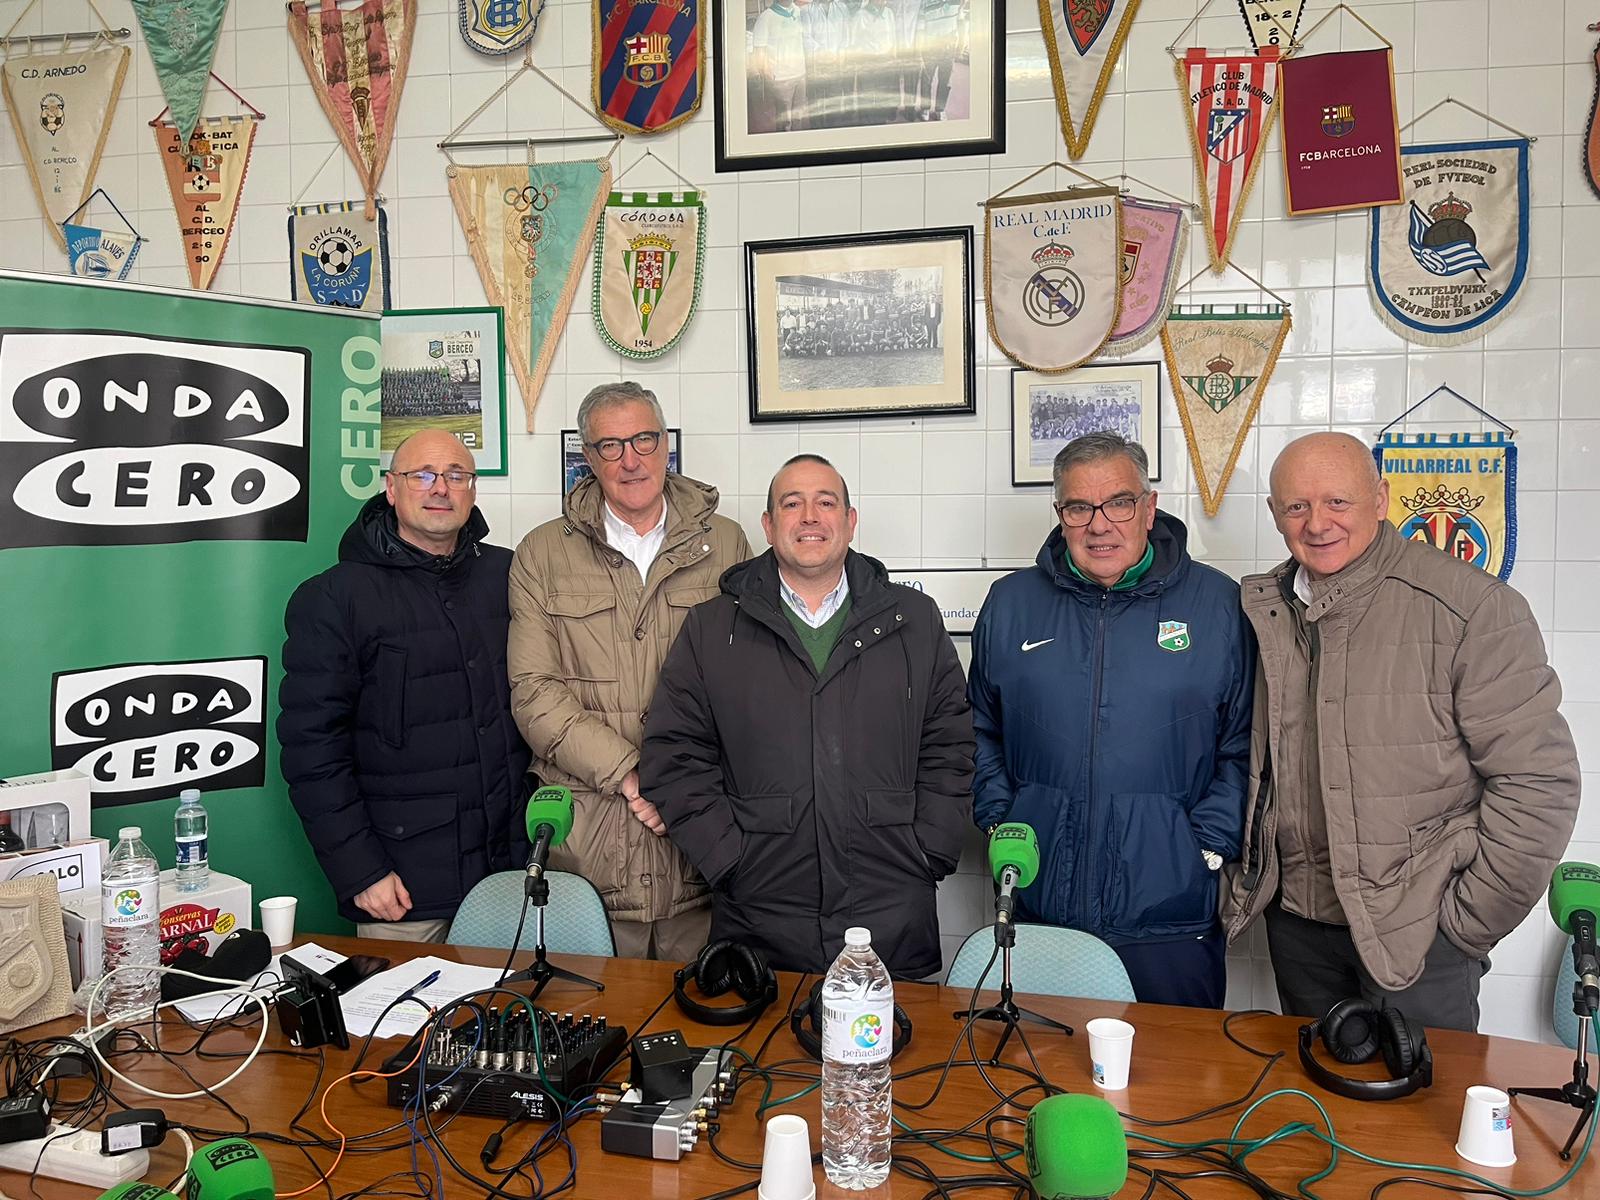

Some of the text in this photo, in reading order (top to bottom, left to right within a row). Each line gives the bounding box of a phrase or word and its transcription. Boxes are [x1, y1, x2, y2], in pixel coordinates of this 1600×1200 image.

[21, 64, 87, 79] C.D. ARNEDO
[1221, 71, 1245, 80] CLUB
[1229, 81, 1240, 91] DE
[1242, 82, 1274, 105] MADRID
[1299, 144, 1382, 162] FCBARCELONA
[1402, 158, 1498, 178] REAL SOCIEDAD
[1413, 176, 1433, 189] DE
[620, 210, 685, 223] CÓRDOBA
[994, 203, 1112, 228] REAL MADRID
[182, 228, 225, 236] BERCEO
[309, 226, 363, 251] ORILLAMAR
[195, 255, 210, 263] 90
[311, 267, 321, 282] LA
[1391, 289, 1503, 319] CAMPEON DE LIGA
[447, 344, 474, 354] BERCEO
[634, 339, 653, 348] 1954
[42, 376, 265, 423] ONDA
[340, 334, 382, 500] CERO
[1383, 457, 1504, 474] VILLARREAL C.F.
[55, 459, 267, 508] CERO
[940, 607, 981, 619] undac
[84, 687, 235, 727] ONDA
[92, 740, 235, 782] CERO
[842, 1046, 888, 1059] peñaclara
[510, 1090, 544, 1101] ALESIS
